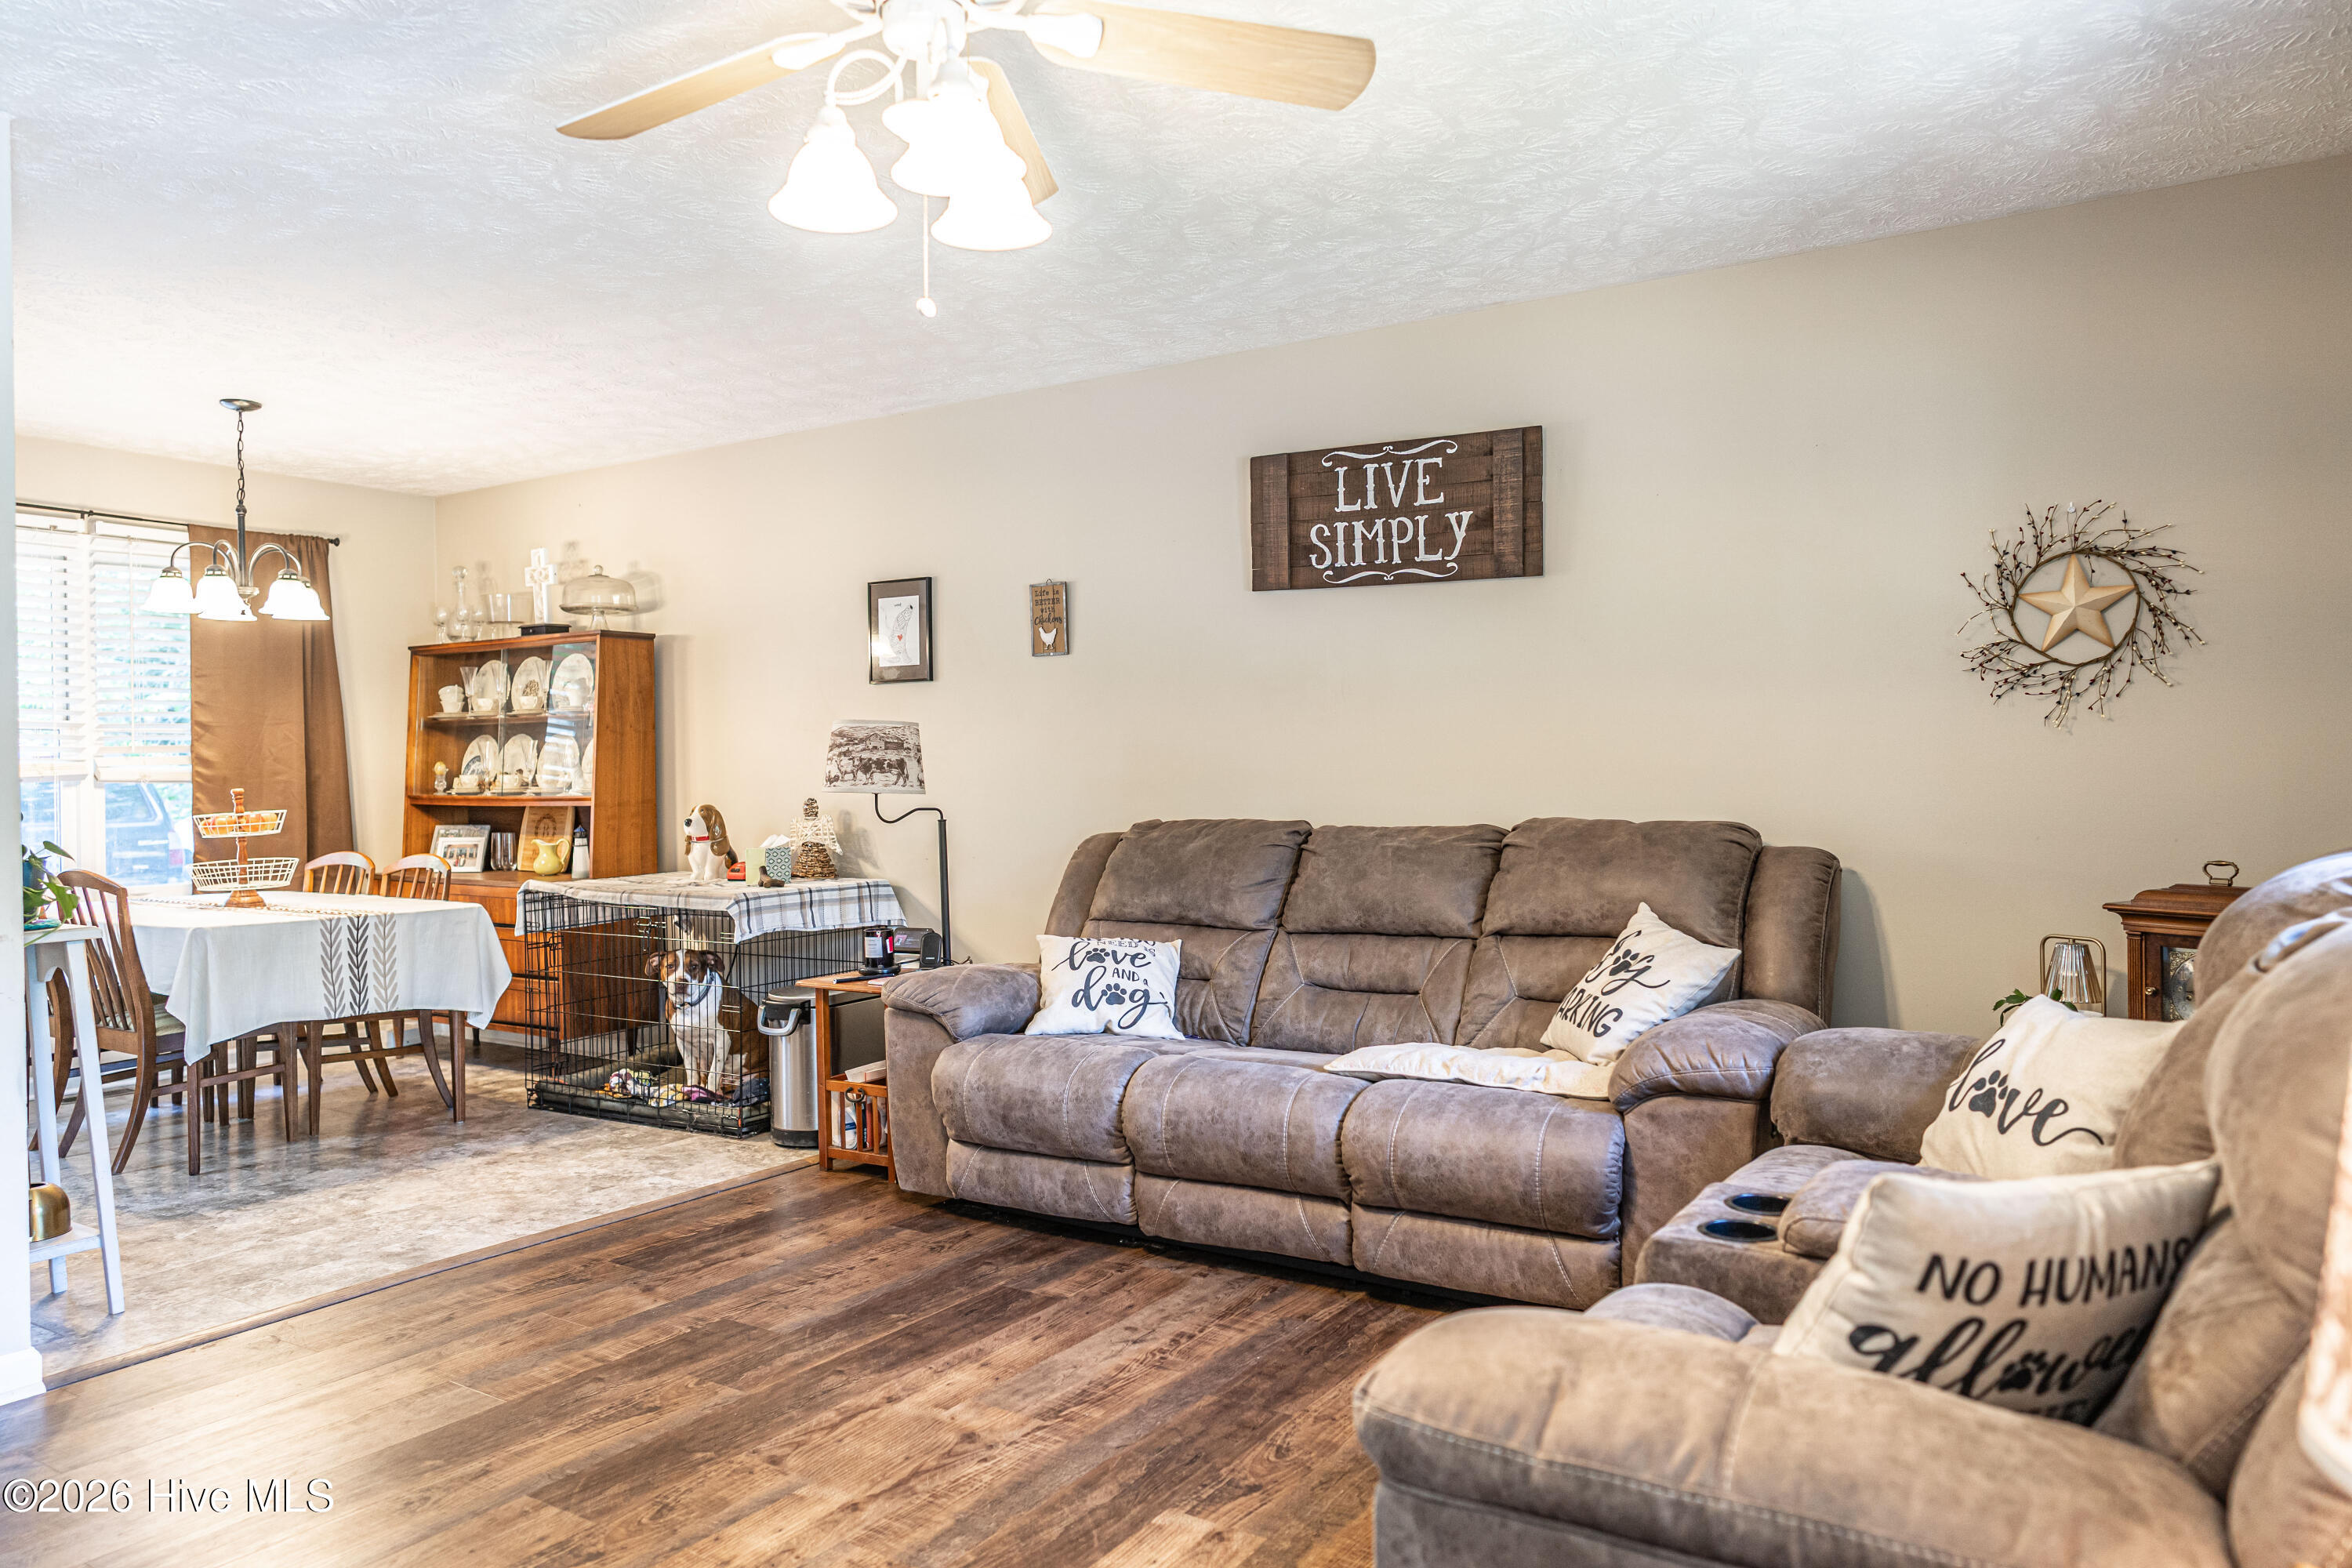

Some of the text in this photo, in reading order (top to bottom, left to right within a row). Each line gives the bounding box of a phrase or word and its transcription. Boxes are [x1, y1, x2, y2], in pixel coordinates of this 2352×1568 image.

[1334, 456, 1444, 513] LIVE
[1035, 597, 1060, 606] BETTER
[1112, 967, 1140, 982] AND
[1916, 1254, 2002, 1306] NO
